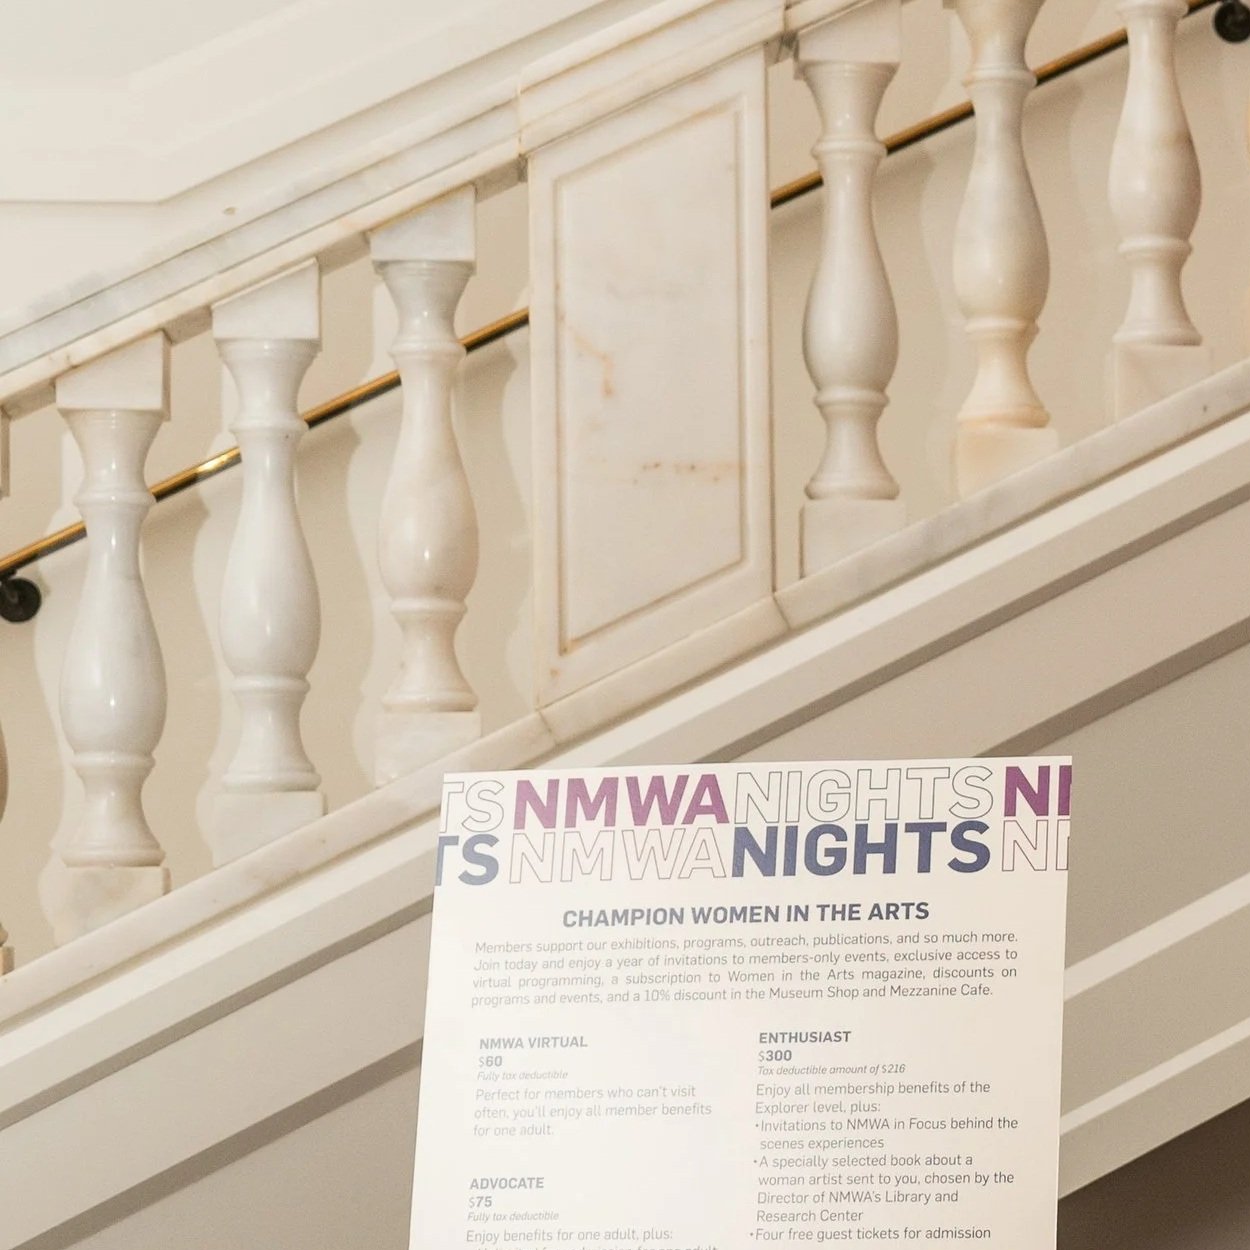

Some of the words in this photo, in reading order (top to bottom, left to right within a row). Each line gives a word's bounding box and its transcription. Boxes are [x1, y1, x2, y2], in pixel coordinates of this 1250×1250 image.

[513, 774, 730, 831] NMWA
[734, 765, 994, 825] NIGHTS
[508, 827, 728, 884] NMWA
[731, 820, 991, 879] NIGHTS
[563, 907, 684, 927] CHAMPION
[691, 905, 780, 924] WOMEN
[786, 904, 809, 922] IN
[815, 903, 862, 921] THE
[867, 901, 929, 920] ARTS
[475, 941, 532, 953] Members
[536, 940, 583, 953] support
[586, 941, 607, 950] our
[610, 937, 679, 950] exhibitions,
[683, 938, 746, 951] programs,
[750, 933, 809, 947] outreach,
[813, 932, 893, 948] publications,
[896, 931, 920, 944] and
[923, 934, 939, 944] so
[942, 930, 978, 943] much
[981, 932, 1018, 943] more.
[479, 1037, 524, 1050] NMWA
[527, 1035, 588, 1049] VIRTUAL
[759, 1030, 852, 1044] ENTHUSIAST
[478, 1055, 503, 1068] $60
[758, 1049, 792, 1062] $300
[469, 1176, 545, 1190] ADVOCATE
[468, 1195, 492, 1208] $75
